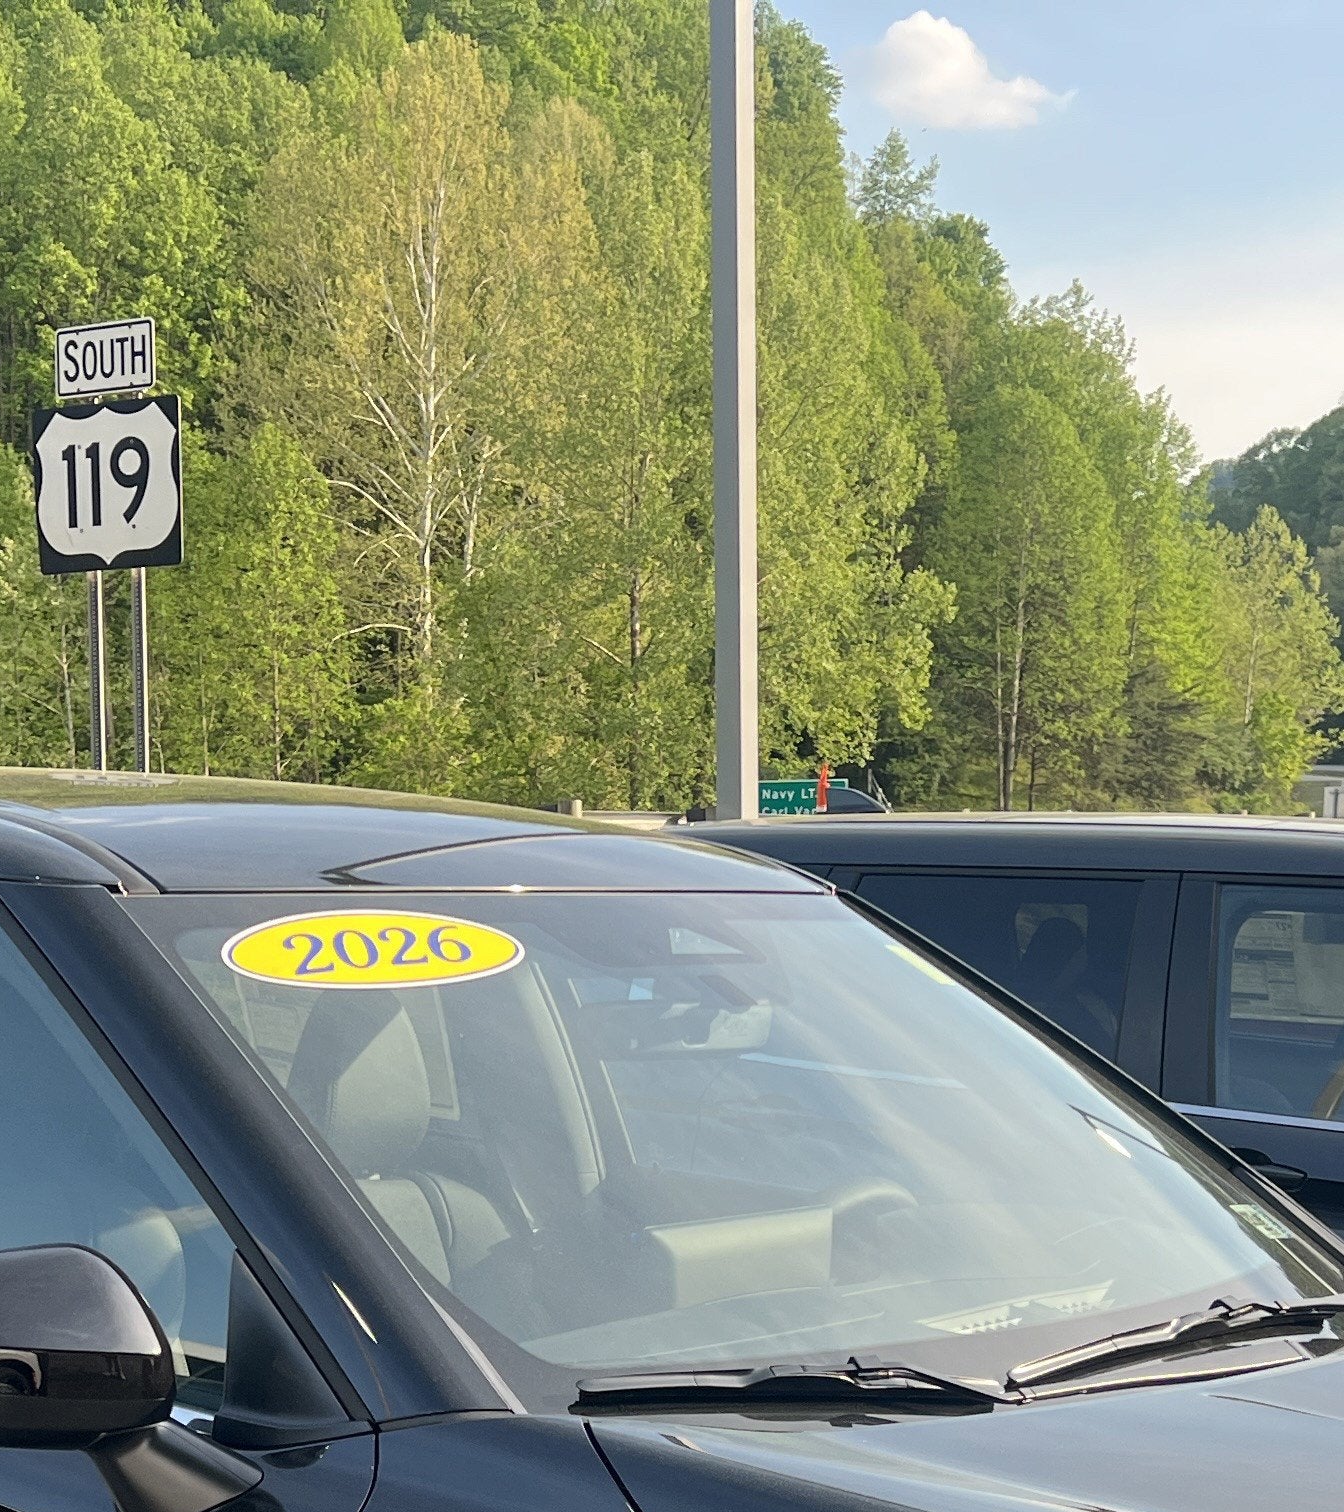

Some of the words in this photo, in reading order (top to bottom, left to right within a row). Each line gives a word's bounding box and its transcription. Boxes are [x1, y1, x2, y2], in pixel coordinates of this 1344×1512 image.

[64, 334, 146, 382] SOUTH
[61, 436, 150, 529] 119
[761, 788, 795, 802] Navy
[282, 925, 472, 976] 2026
